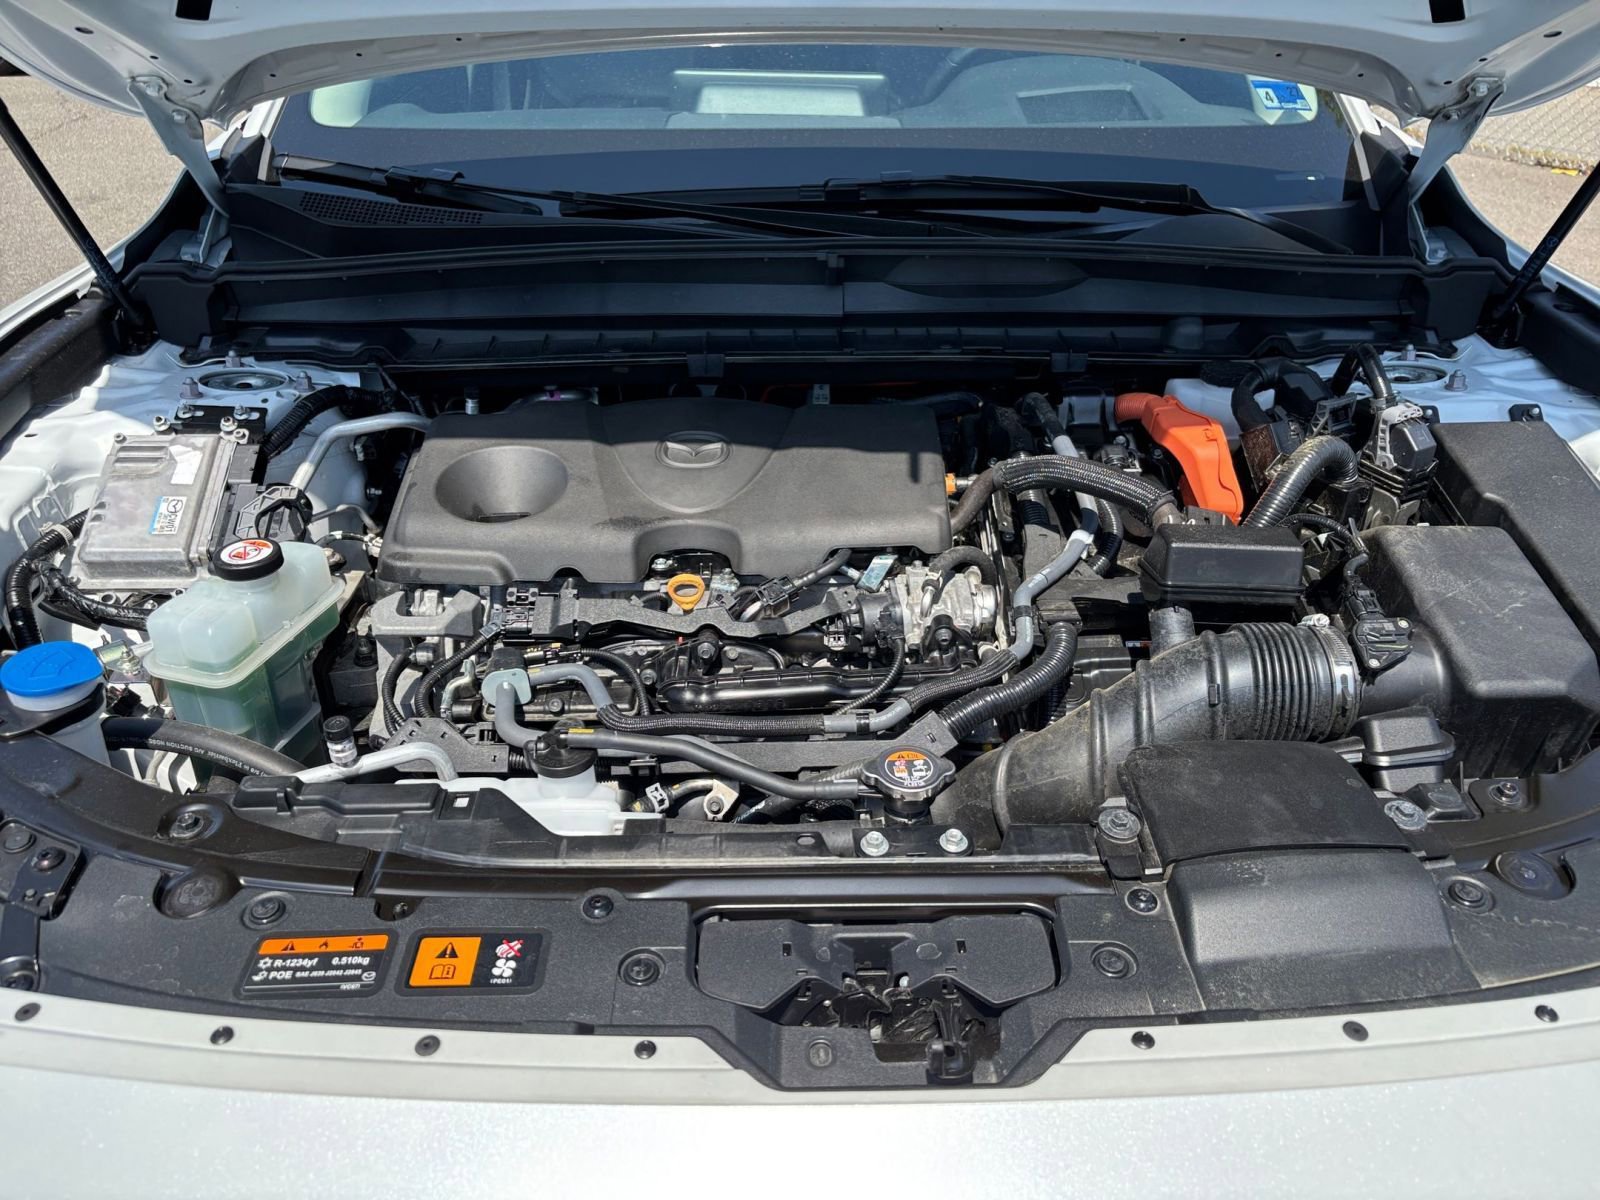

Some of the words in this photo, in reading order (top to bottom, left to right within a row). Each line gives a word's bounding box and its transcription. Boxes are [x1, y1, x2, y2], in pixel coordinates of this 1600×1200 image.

[1265, 91, 1273, 103] 4
[166, 741, 193, 751] SUCTION
[273, 957, 319, 968] R-1234yf
[331, 956, 371, 966] 0.510kg
[268, 971, 293, 980] POE
